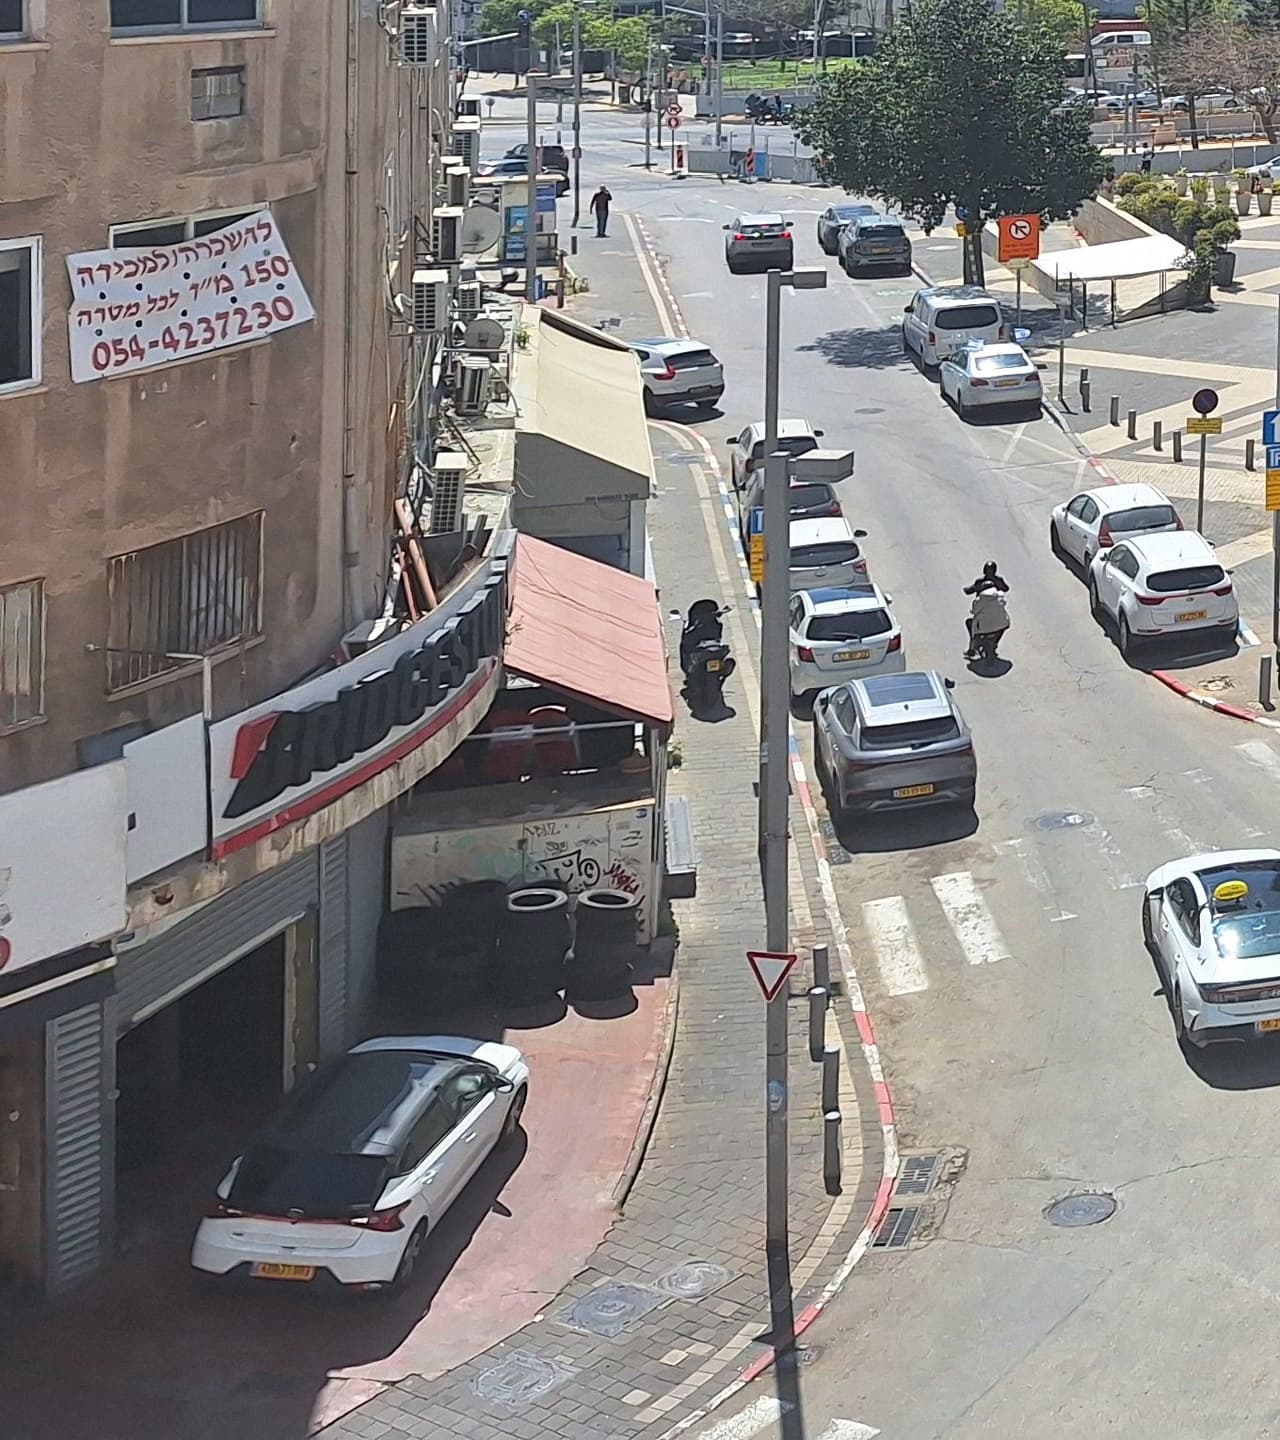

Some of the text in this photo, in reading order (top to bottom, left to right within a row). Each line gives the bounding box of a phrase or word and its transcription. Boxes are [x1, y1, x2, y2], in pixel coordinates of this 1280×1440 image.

[76, 218, 272, 288] להשכרה ולמכירה
[240, 255, 290, 288] 150
[76, 301, 140, 328] מטרה
[146, 288, 180, 315] לכל
[92, 295, 294, 371] 054-4237230
